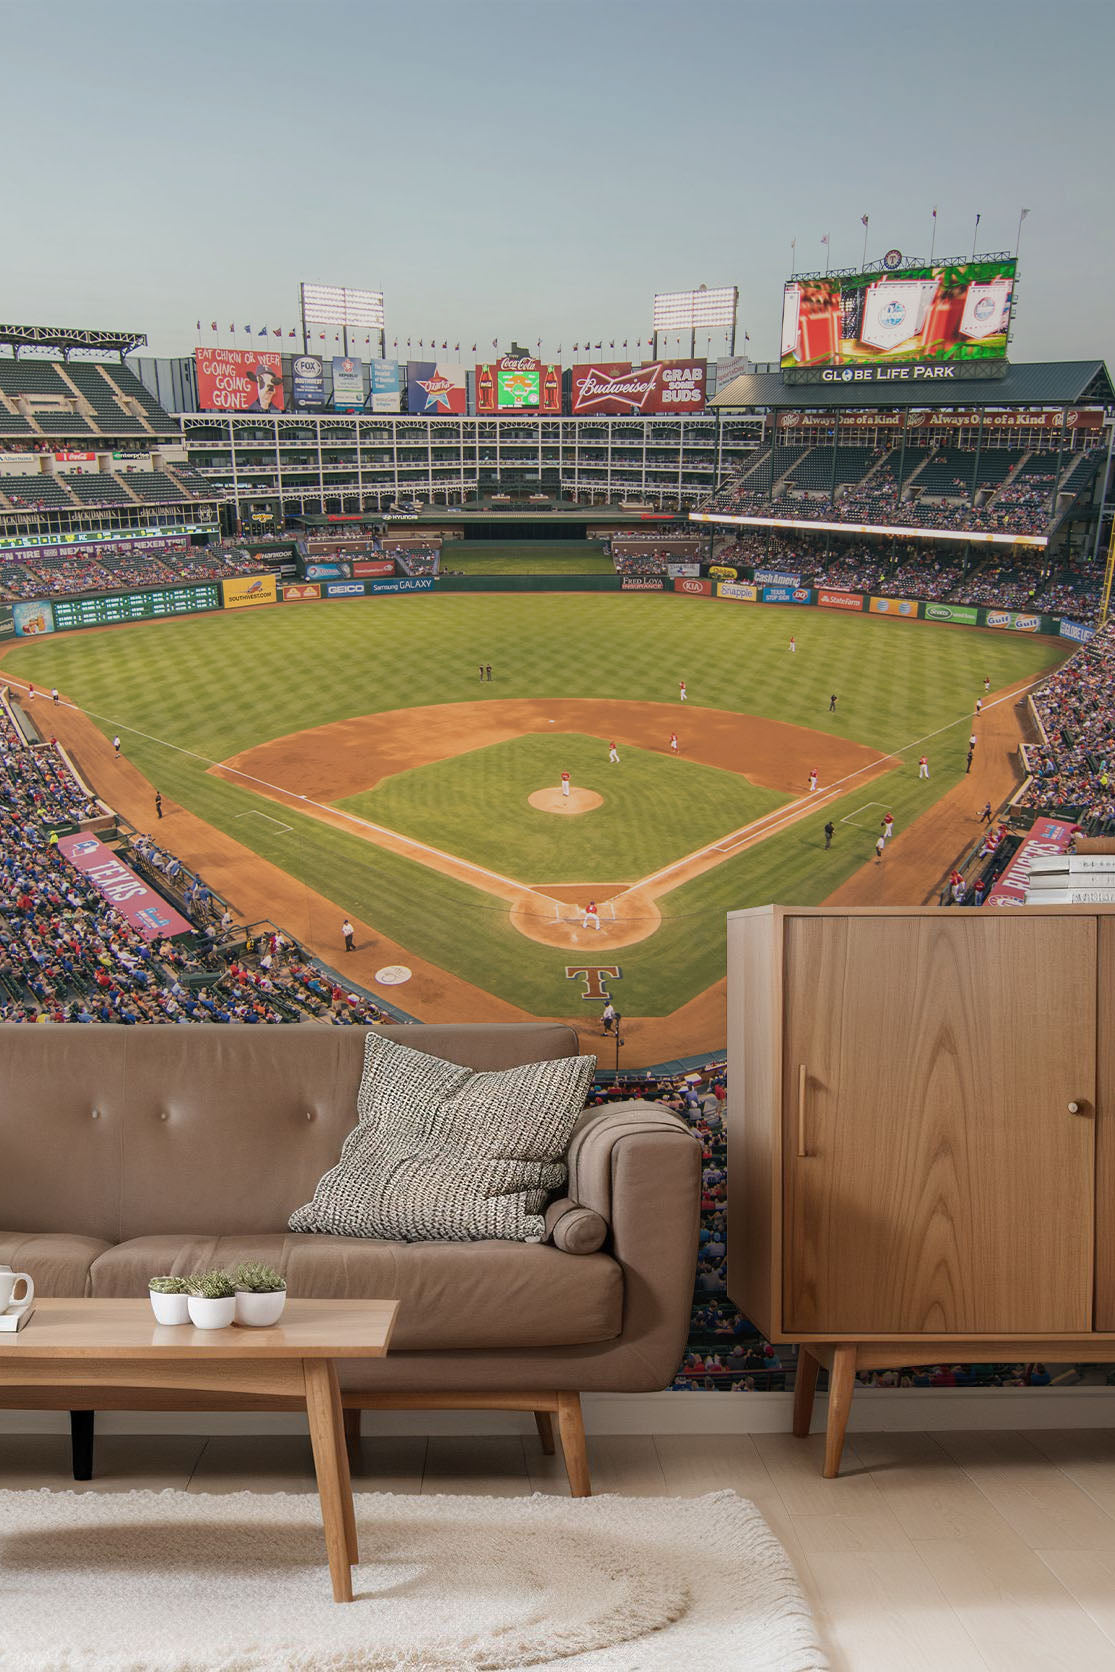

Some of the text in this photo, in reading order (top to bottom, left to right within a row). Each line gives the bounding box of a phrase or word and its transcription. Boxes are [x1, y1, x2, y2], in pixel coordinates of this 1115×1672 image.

[198, 349, 280, 366] EAT CHIKIN OR WEER
[202, 361, 236, 377] GOING
[300, 361, 316, 370] FOX
[662, 368, 703, 382] GRAB
[822, 366, 955, 381] GLOBE LIFE PARK
[215, 375, 252, 392] GOING
[576, 378, 656, 397] Budweiser
[668, 381, 695, 389] SOME
[212, 390, 249, 408] GONE
[661, 389, 702, 403] BUDS
[801, 416, 836, 425] Always
[856, 415, 867, 424] of
[874, 415, 899, 424] Kind
[930, 414, 969, 425] Always
[994, 414, 1006, 424] of
[1016, 414, 1046, 424] Kind
[133, 540, 165, 549] NEXEN
[15, 550, 40, 559] TIRE
[60, 545, 94, 555] NEXEN
[399, 579, 432, 590] GALAXY
[623, 576, 663, 585] FRED LOYA
[328, 585, 364, 594] GEICO
[685, 583, 700, 591] KIA
[721, 585, 753, 598] Snapple
[228, 592, 272, 602] SOUTHWEST.COM
[930, 607, 949, 617] Scotts
[988, 615, 1009, 624] Gulf
[1015, 619, 1037, 628] Gulf
[86, 860, 148, 901] TEXAS
[565, 966, 622, 1000] T
